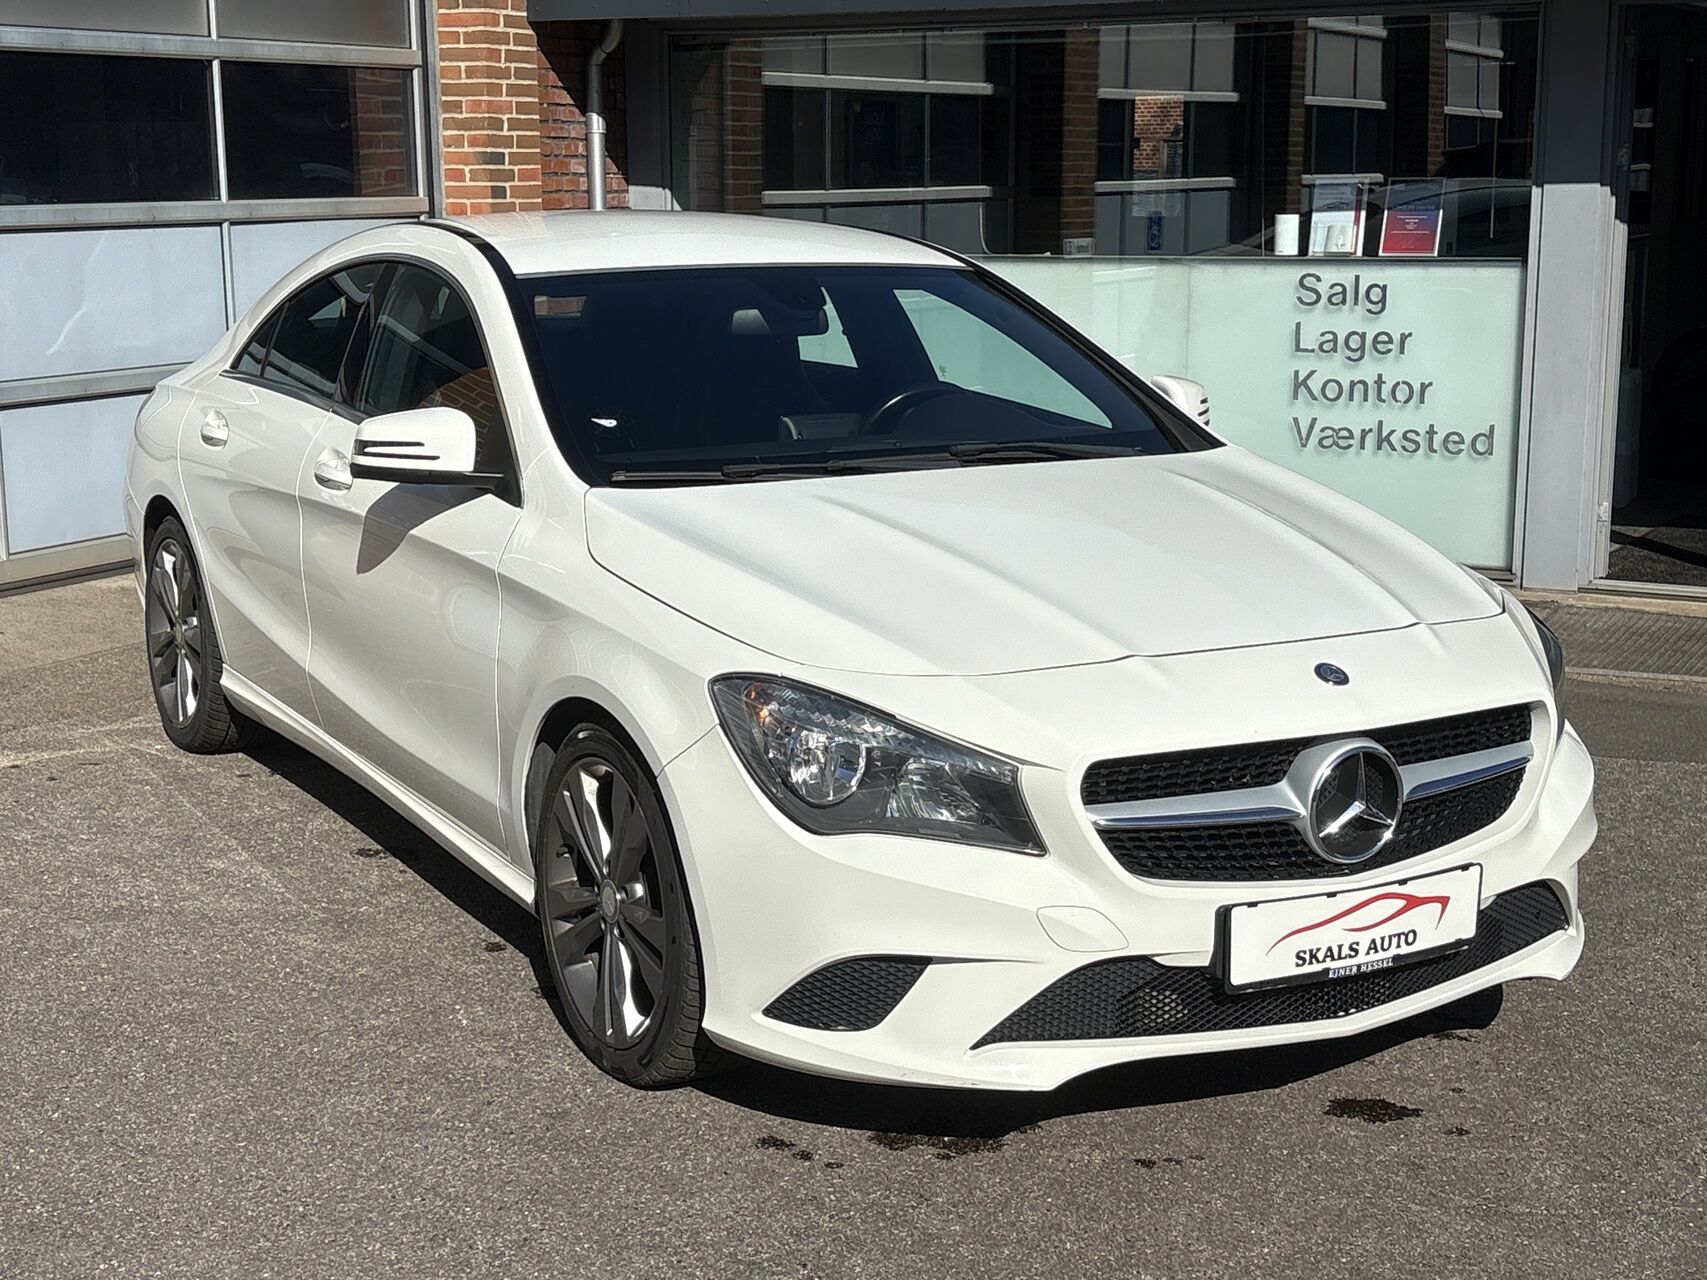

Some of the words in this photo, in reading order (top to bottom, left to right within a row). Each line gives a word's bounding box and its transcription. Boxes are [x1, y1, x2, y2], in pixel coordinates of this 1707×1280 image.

[1296, 272, 1388, 315] Salg
[1294, 321, 1413, 362] Lager
[1292, 369, 1433, 404] Kontor
[1292, 417, 1496, 457] Værksted
[1295, 941, 1360, 967] SKALS
[1364, 929, 1418, 956] AUTO
[1328, 965, 1358, 978] EJNER
[1360, 958, 1394, 973] HESSEL
